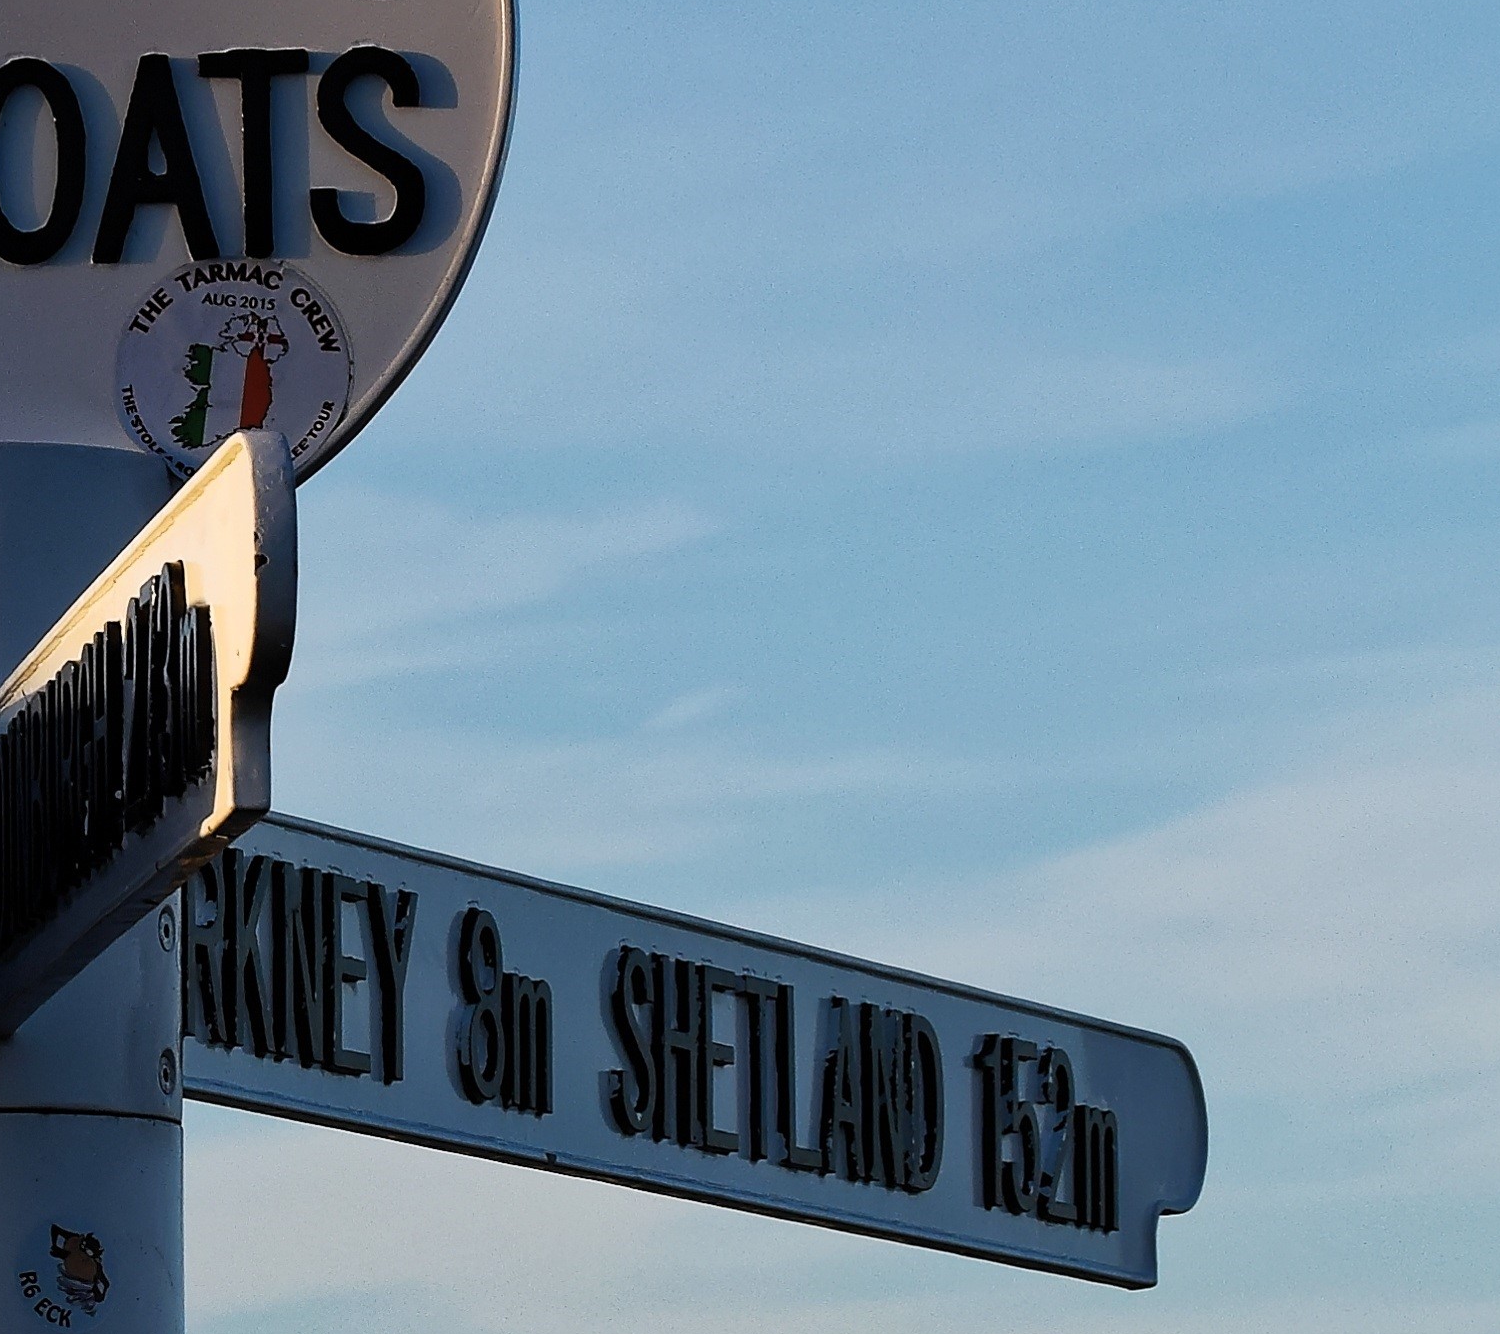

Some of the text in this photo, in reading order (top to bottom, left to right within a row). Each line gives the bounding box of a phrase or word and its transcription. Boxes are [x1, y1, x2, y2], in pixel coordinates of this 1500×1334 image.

[129, 262, 341, 353] THE TARMAC CREW
[201, 293, 276, 311] AUG 2015
[121, 384, 138, 415] THE
[306, 401, 335, 438] TOUR
[181, 847, 1120, 1233] RKNEY 8m SHETLAND 152m
[19, 1271, 72, 1328] R6 ECK
